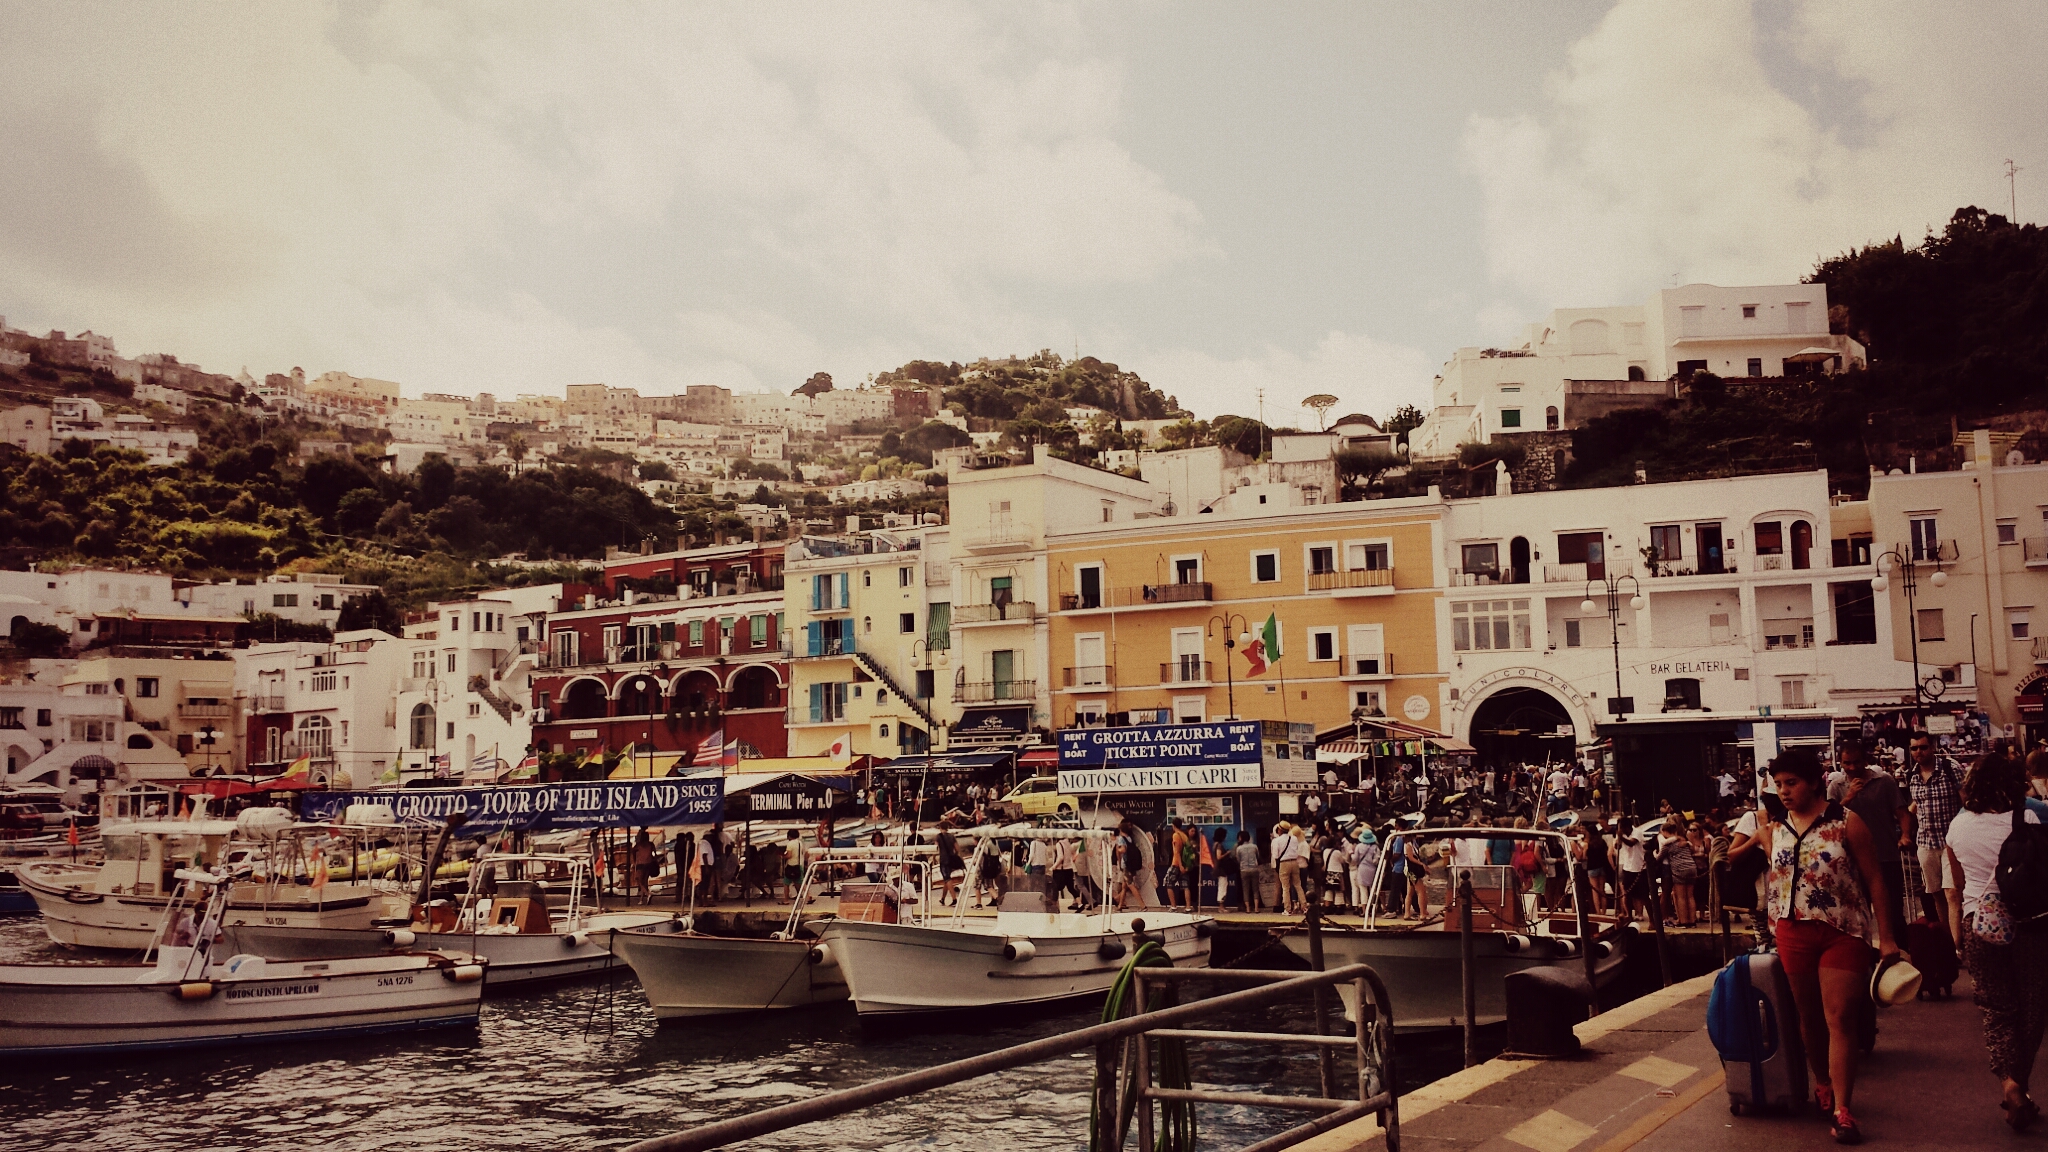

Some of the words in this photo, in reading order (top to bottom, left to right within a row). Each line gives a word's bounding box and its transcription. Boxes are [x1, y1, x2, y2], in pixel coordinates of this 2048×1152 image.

[1650, 663, 1671, 675] BAR
[1675, 660, 1731, 674] GELATERIA
[1459, 668, 1579, 705] FUNICOLARE
[2014, 668, 2048, 692] PIZZERIA
[1092, 730, 1152, 745] GROTTA
[1153, 726, 1226, 742] AZZURRA
[1229, 724, 1255, 734] RENT
[1063, 732, 1087, 742] RENT
[1239, 734, 1247, 743] A
[1072, 741, 1079, 750] A
[1105, 745, 1157, 759] TICKET
[1159, 743, 1203, 757] POINT
[1230, 742, 1256, 752] BOAT
[1064, 749, 1088, 758] BOAT
[1062, 770, 1179, 789] MOTOSCAFISTI
[1187, 768, 1237, 785] CAPRI
[681, 784, 718, 798] SINCE
[397, 793, 468, 817] GROTTO
[481, 791, 531, 815] TOUR
[534, 786, 561, 813] OF
[563, 787, 602, 811] THE
[605, 784, 679, 810] ISLAND
[688, 800, 712, 814] 1955
[751, 793, 792, 811] TERMINAL
[796, 792, 814, 810] Pier
[395, 976, 414, 985] 1276
[226, 984, 319, 999] MOTOSCAFISTICAPRI.COM
